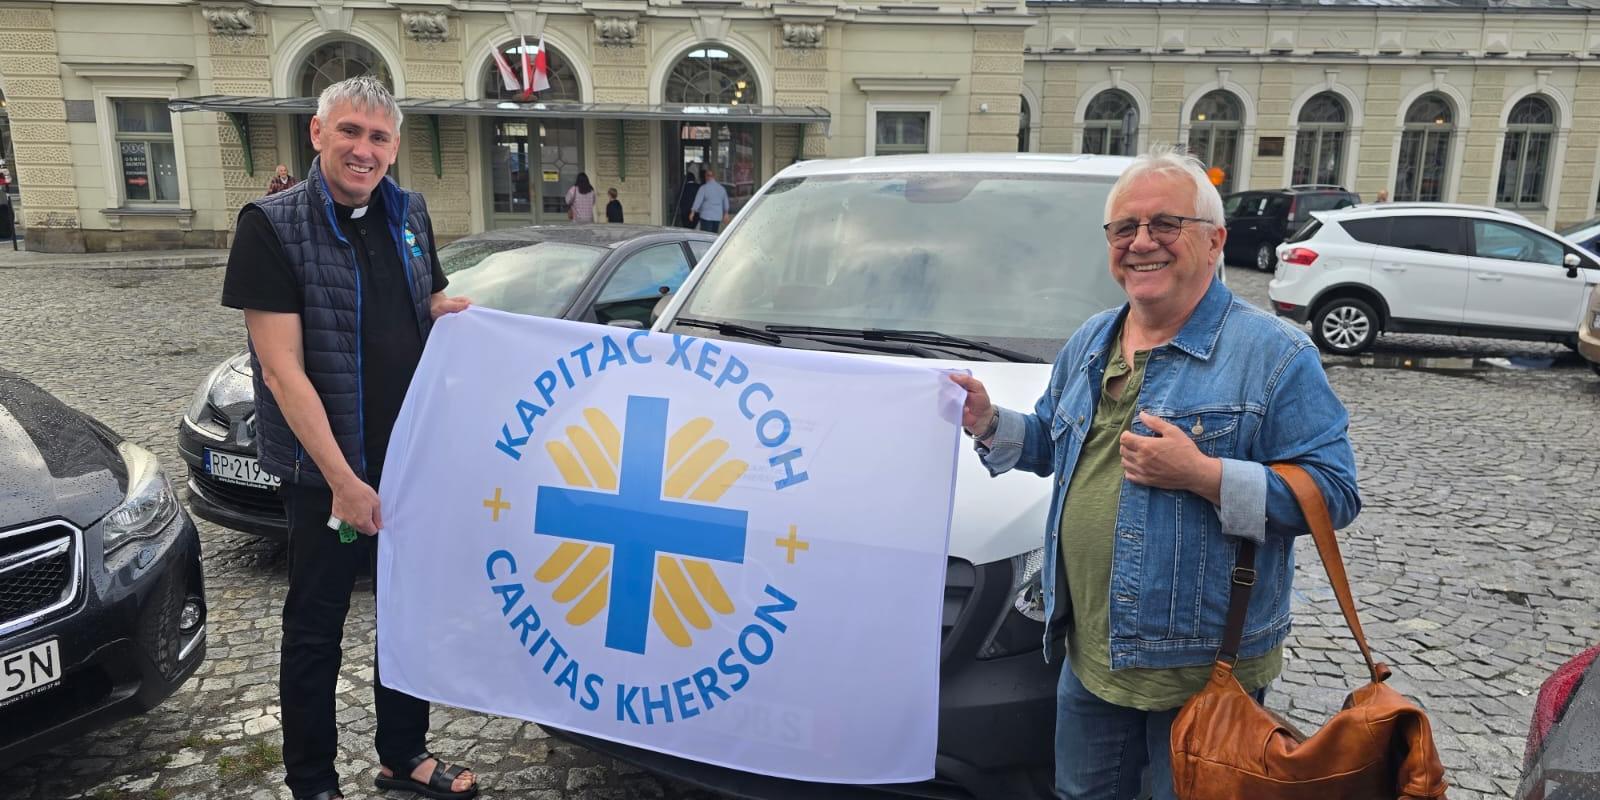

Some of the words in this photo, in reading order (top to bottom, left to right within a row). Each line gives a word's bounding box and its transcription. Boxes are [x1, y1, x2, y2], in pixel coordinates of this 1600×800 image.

[495, 330, 653, 461] КАРІТАС
[665, 335, 808, 490] ХЕРСОН
[4, 645, 54, 691] 5N
[486, 549, 604, 711] CARITAS
[616, 584, 798, 725] KHERSON
